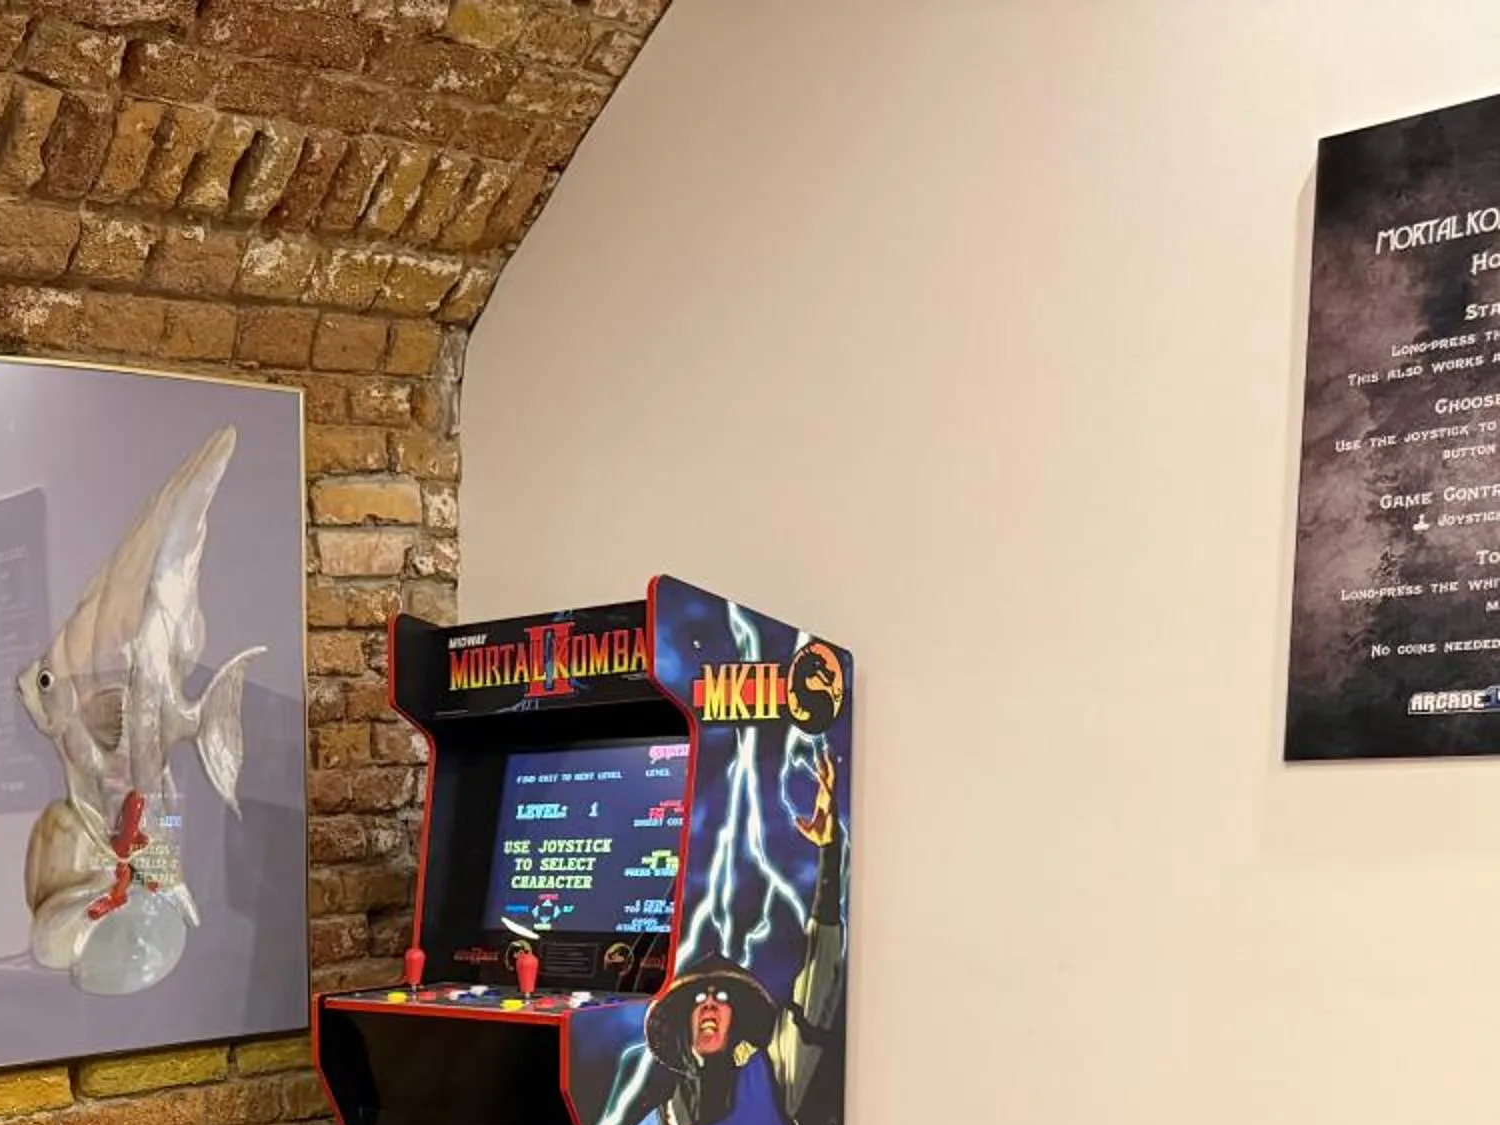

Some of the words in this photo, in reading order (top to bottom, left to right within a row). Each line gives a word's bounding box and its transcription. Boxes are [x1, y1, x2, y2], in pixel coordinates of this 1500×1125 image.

[1375, 215, 1465, 255] MORTAL
[1466, 207, 1500, 236] KO
[1348, 372, 1380, 386] THIS
[1387, 365, 1424, 381] ALSO
[1431, 355, 1485, 374] WORKS
[1335, 440, 1362, 453] USE
[1369, 435, 1397, 448] THE
[1403, 425, 1469, 443] JOYSTICK
[1478, 421, 1497, 433] TO
[1442, 444, 1497, 461] BUTTON
[1380, 492, 1434, 509] GAME
[1429, 580, 1459, 593] THE
[448, 634, 488, 649] MIDWAY
[449, 641, 547, 691] MORTAL
[552, 628, 648, 679] KOMBA
[1371, 644, 1391, 659] NO
[702, 663, 780, 721] MKII
[515, 803, 568, 820] LEVEL:
[588, 801, 599, 817] 1
[503, 840, 531, 854] USE
[537, 838, 612, 853] JOYSTICK
[515, 858, 533, 871] TO
[540, 857, 597, 871] SELECT
[511, 875, 593, 889] CHARACTER
